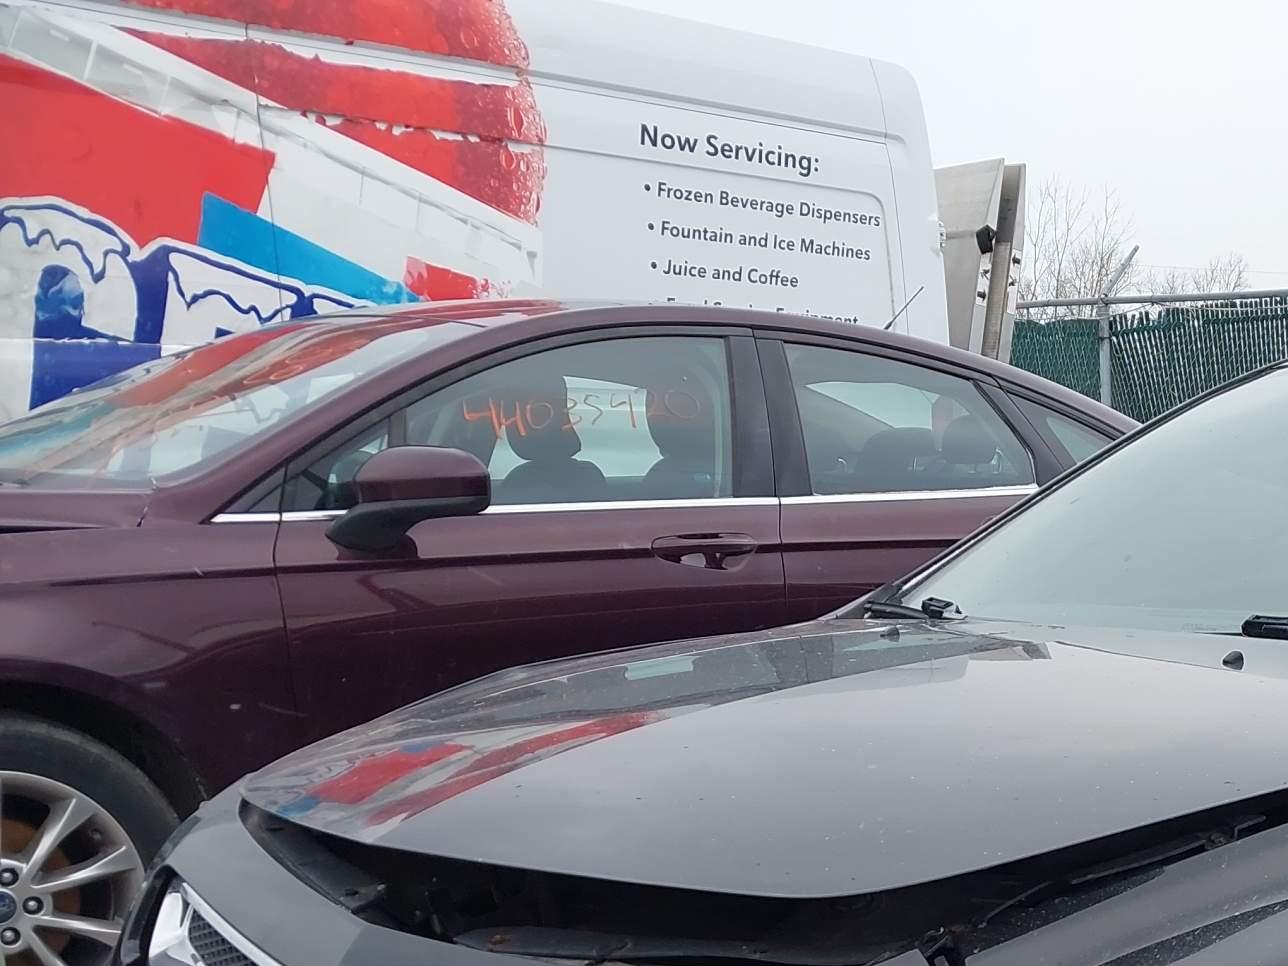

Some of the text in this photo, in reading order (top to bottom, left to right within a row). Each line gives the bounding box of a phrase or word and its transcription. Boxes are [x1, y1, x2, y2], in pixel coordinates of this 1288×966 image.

[641, 124, 819, 177] Now Servicing:
[657, 182, 881, 227] Frozen Beverage Dispensers
[661, 221, 871, 261] Fountain and Ice Machines
[662, 259, 799, 288] Juice and Coffee
